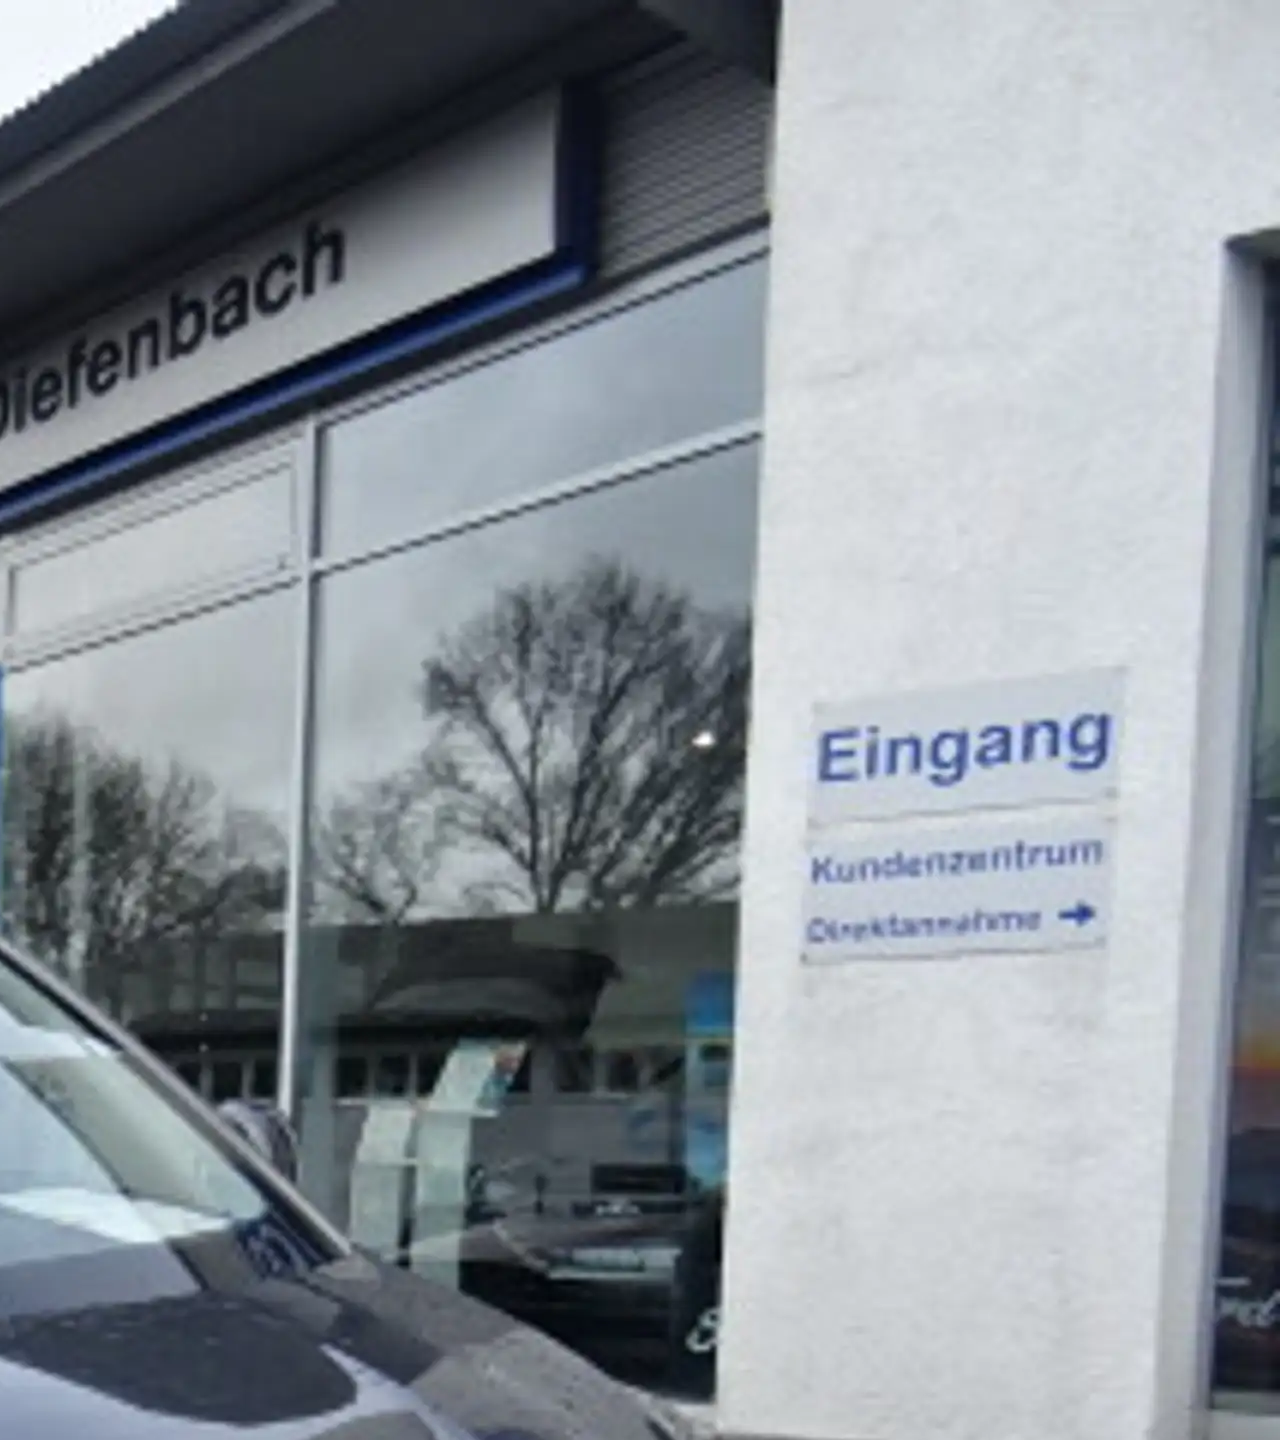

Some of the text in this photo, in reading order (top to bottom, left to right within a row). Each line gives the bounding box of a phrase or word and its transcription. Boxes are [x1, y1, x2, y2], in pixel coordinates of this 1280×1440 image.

[817, 712, 1112, 787] Eingang
[811, 839, 1103, 885] Kundenzentrum
[805, 908, 1042, 944] Direktannahme
